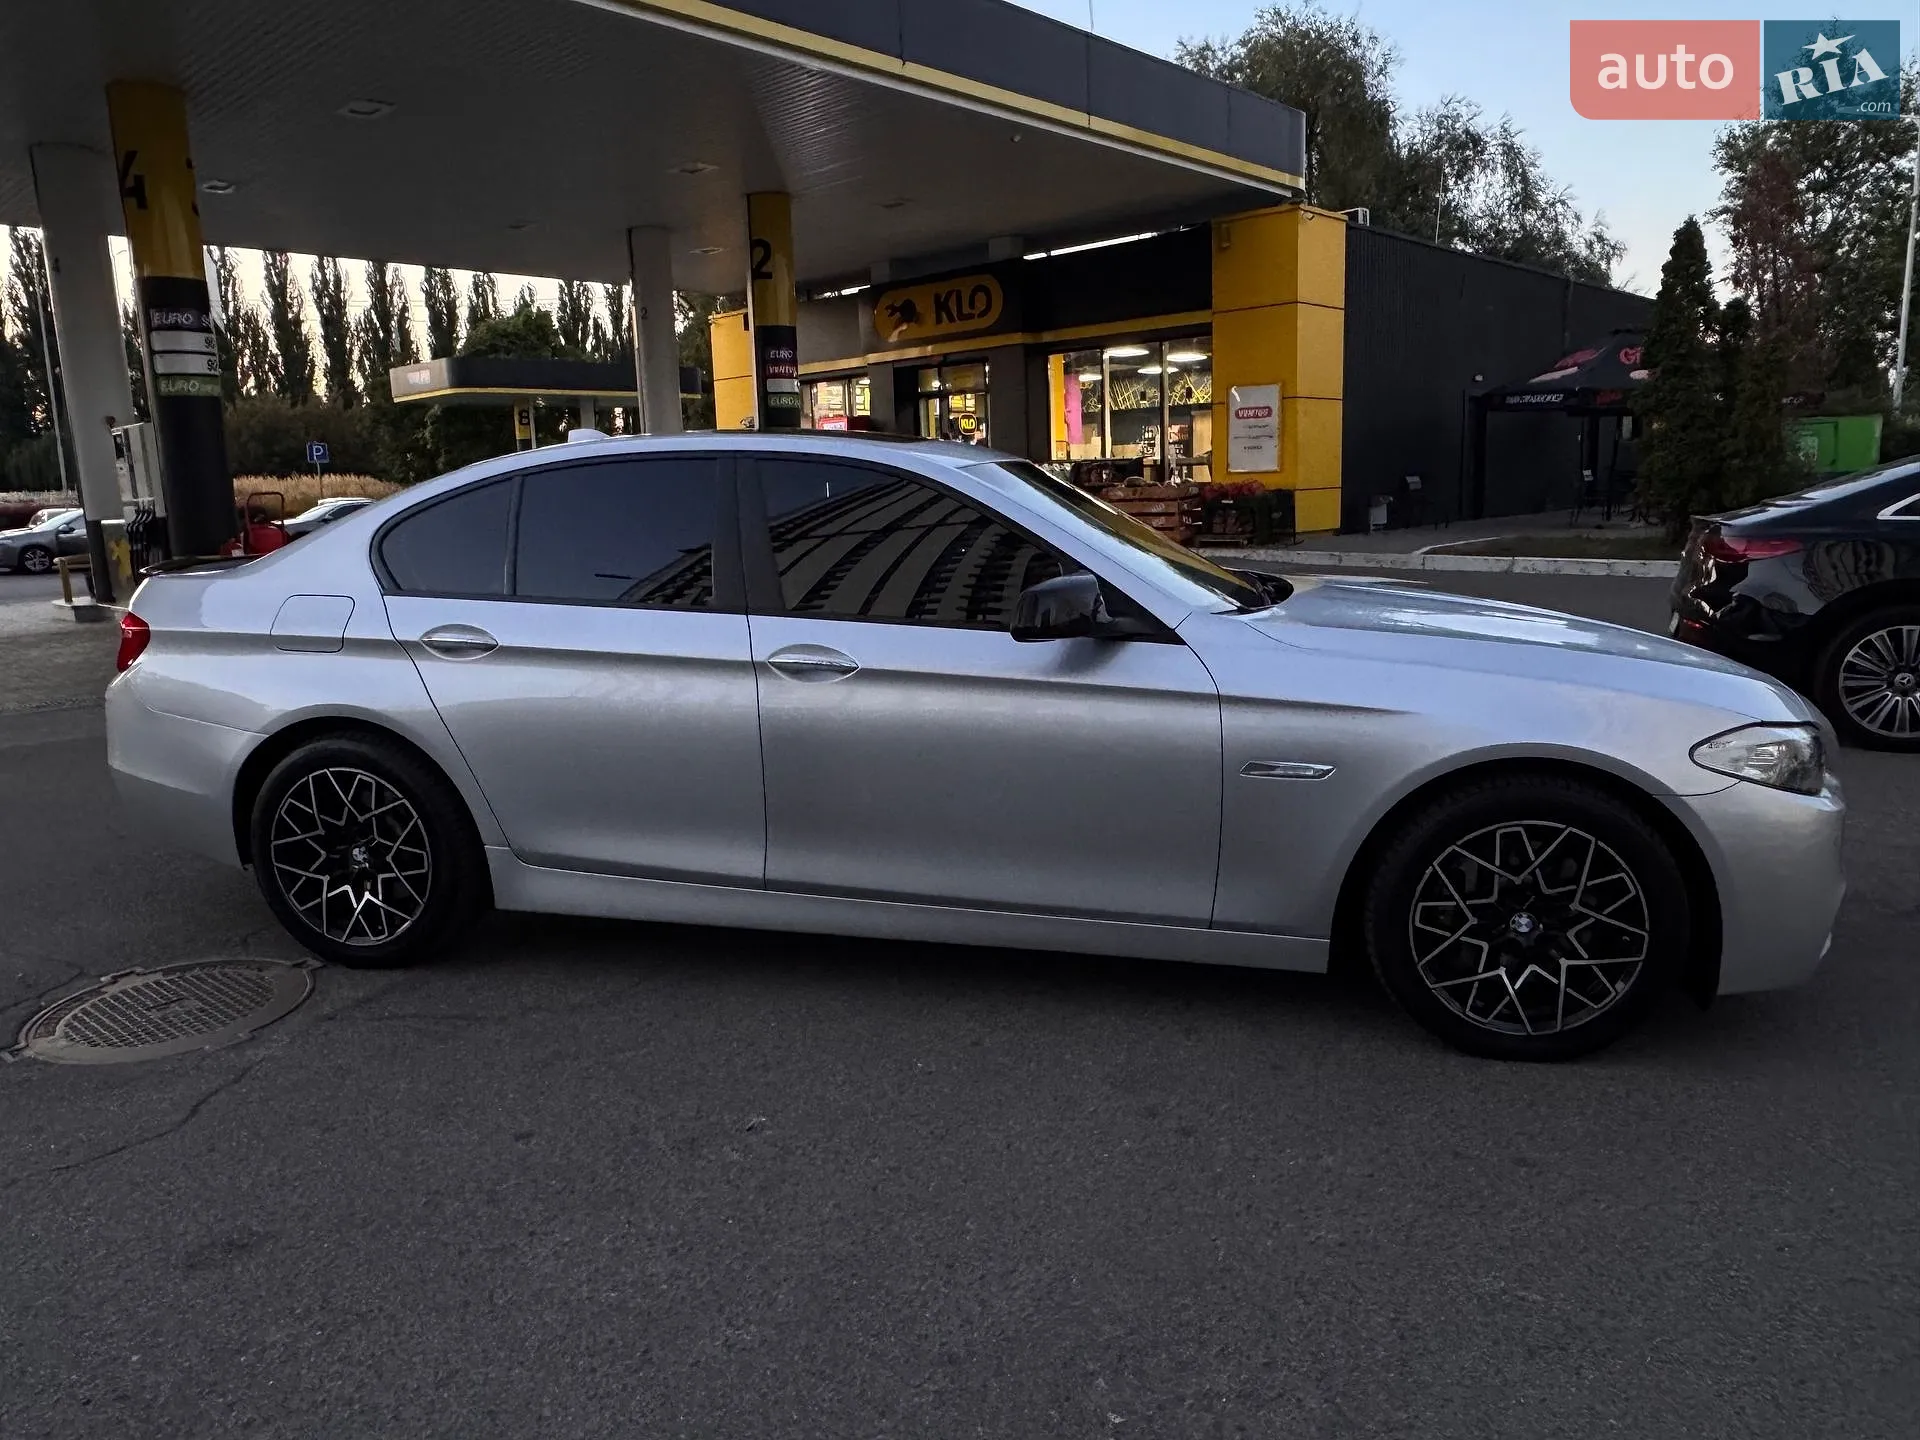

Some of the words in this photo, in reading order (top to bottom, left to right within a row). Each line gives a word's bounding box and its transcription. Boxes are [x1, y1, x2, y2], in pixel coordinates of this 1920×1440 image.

[118, 150, 148, 210] 4
[751, 238, 772, 280] 2
[153, 311, 193, 326] EURO
[933, 284, 993, 325] KLO
[961, 418, 976, 430] KLO
[313, 445, 324, 461] P
